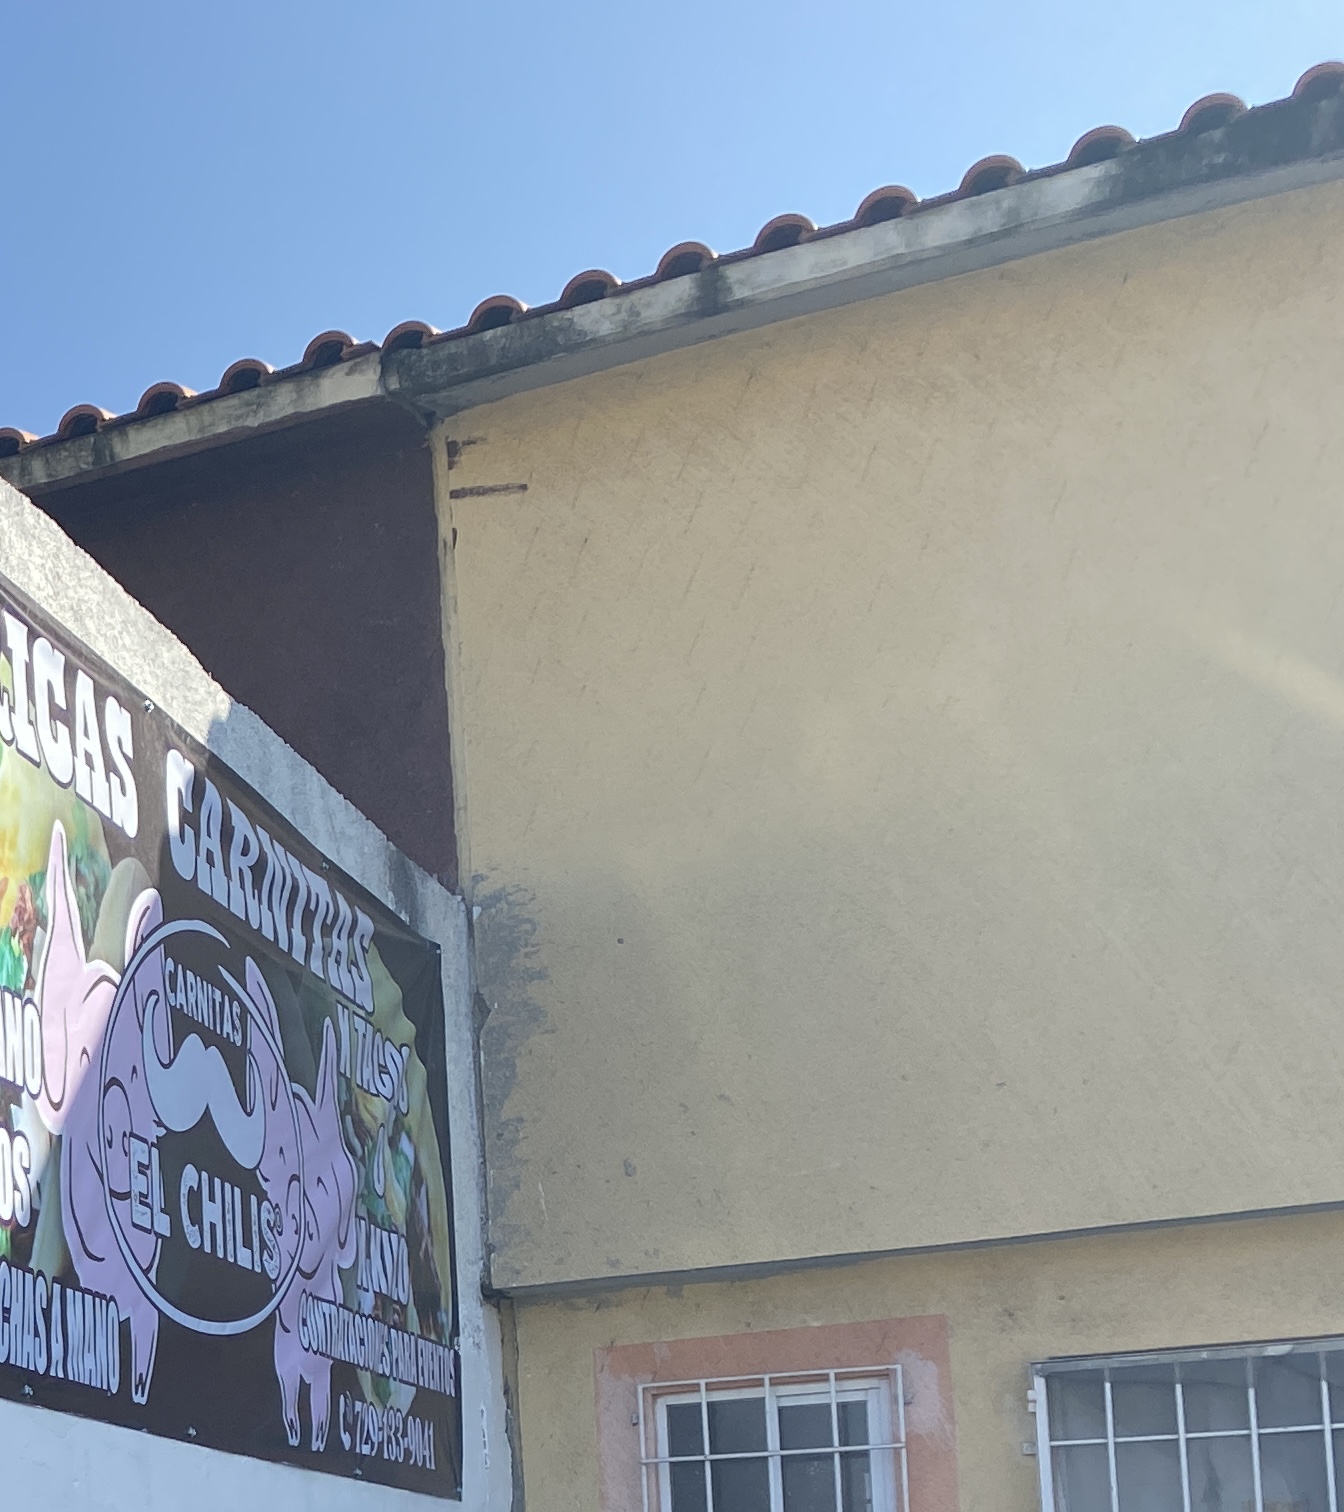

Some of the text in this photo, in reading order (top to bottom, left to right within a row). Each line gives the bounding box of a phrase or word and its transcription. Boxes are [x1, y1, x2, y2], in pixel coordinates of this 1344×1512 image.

[166, 749, 375, 1013] CARNITAS
[164, 957, 243, 1046] CARNITAS
[129, 1132, 171, 1238] EL
[49, 1282, 65, 1378] A
[66, 1287, 121, 1395] MANO
[391, 1328, 417, 1385] PARA
[417, 1336, 456, 1398] EVENTOS
[355, 1401, 436, 1470] 729-133-9041
